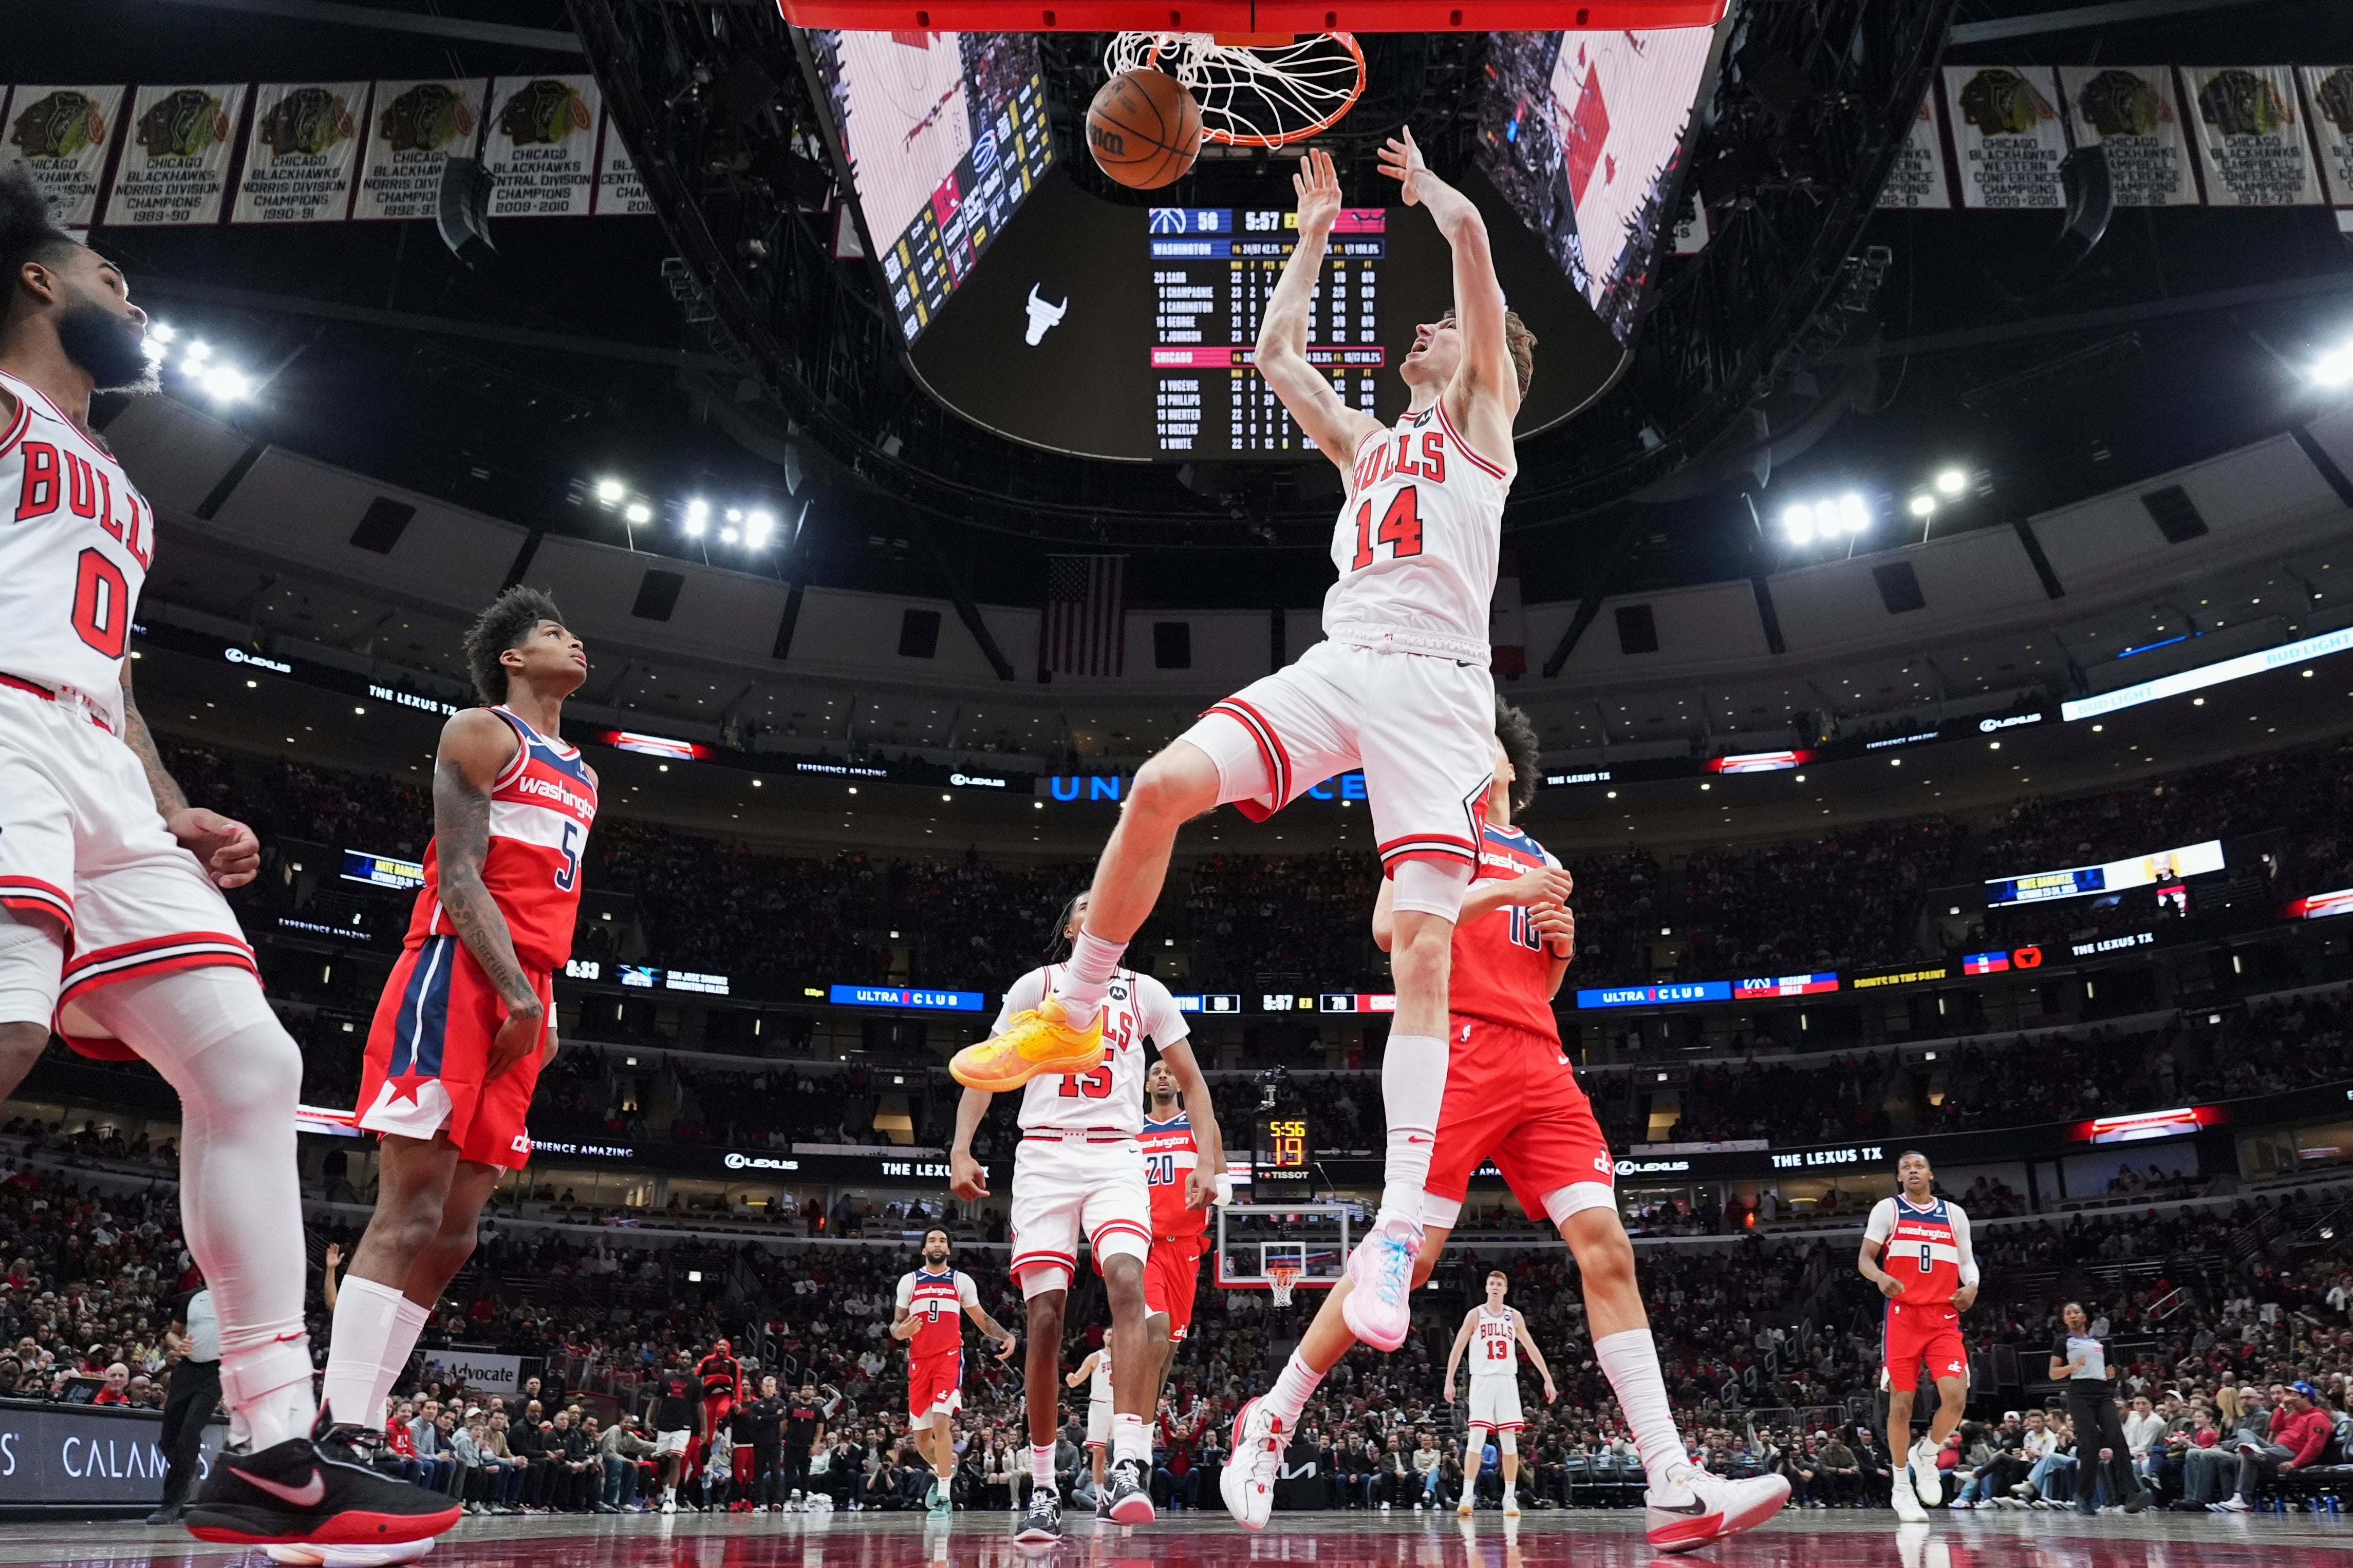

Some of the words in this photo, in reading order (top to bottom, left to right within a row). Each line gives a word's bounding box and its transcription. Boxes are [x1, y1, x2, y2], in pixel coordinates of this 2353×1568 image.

[271, 155, 327, 168] CHICAGO
[512, 148, 568, 161] CHICAGO
[147, 157, 202, 170] CHICAGO
[493, 161, 582, 174] BLACKHAWKS
[127, 169, 215, 183] BLACKHAWKS
[251, 166, 341, 180] BLACKHAWKS
[541, 173, 591, 185] DIVISION
[115, 184, 162, 196] NORRIS
[166, 182, 220, 195] DIVISION
[241, 181, 289, 194] NORRIS
[292, 180, 347, 192] DIVISION
[364, 179, 410, 191] NORRIS
[254, 194, 329, 206] CHAMPIONS
[497, 187, 571, 199] CHAMPIONS
[127, 197, 202, 210] CHAMPIONS
[1245, 211, 1280, 231] 5:57
[1153, 243, 1211, 255] WASHINGTON
[1231, 271, 1242, 284] 22
[1250, 271, 1255, 284] 1
[1265, 271, 1272, 284] 7
[1231, 286, 1242, 298] 23
[1249, 286, 1256, 298] 2
[1231, 300, 1242, 313] 24
[1231, 315, 1242, 328] 21
[1249, 315, 1256, 328] 2
[1250, 330, 1256, 343] 1
[1154, 351, 1193, 364] CHICAGO
[1231, 380, 1242, 392] 22
[1167, 394, 1201, 406] PHILLIPS
[1250, 394, 1256, 406] 1
[1231, 409, 1242, 421] 22
[1250, 409, 1256, 421] 1
[1266, 409, 1273, 421] 5
[1282, 409, 1288, 421] 2
[1282, 423, 1288, 435] 5
[1167, 438, 1192, 449] WHITE
[1231, 438, 1243, 449] 22
[1250, 438, 1256, 449] 1
[1264, 438, 1274, 449] 12
[1348, 431, 1445, 518] BULLS
[14, 441, 154, 574] BULL
[1350, 484, 1423, 572] 14
[71, 547, 128, 660] 0
[2267, 648, 2300, 665] BUD
[2304, 634, 2351, 656] LIGHT
[243, 653, 291, 673] LEXUS
[369, 685, 394, 701] THE
[397, 692, 438, 712] LEXUS
[441, 703, 458, 716] TX
[2078, 698, 2107, 714] BUD
[2111, 687, 2152, 707] LIGHT
[1996, 713, 2042, 728] LEXUS
[796, 763, 847, 775] EXPERIENCE
[849, 767, 888, 778] AMAZING
[965, 777, 1005, 787] LEXUS
[1546, 776, 1565, 785] THE
[1566, 772, 1597, 783] LEXUS
[1598, 771, 1611, 781] TX
[555, 820, 578, 893] 5
[2016, 876, 2037, 891] NATE
[278, 917, 331, 934] EXPERIENCE
[333, 928, 372, 941] AMAZING
[2071, 946, 2095, 957] THE
[2097, 937, 2134, 953] LEXUS
[2136, 933, 2154, 944] TX
[667, 970, 682, 980] SAN
[682, 972, 700, 983] JOSE
[700, 974, 729, 986] SHARKS
[1778, 974, 1812, 987] WIZARDS
[1853, 975, 1888, 989] POINTS
[1888, 974, 1899, 985] IN
[1900, 971, 1918, 983] THE
[1918, 969, 1946, 981] PAINT
[666, 979, 705, 992] EDMONTON
[704, 984, 730, 995] OILERS
[1779, 985, 1803, 996] BULLS
[856, 990, 899, 1004] ULTRA
[912, 992, 958, 1006] CLUB
[1602, 990, 1645, 1004] ULTRA
[1658, 986, 1705, 1000] CLUB
[1263, 994, 1294, 1011] 5:57
[1332, 996, 1347, 1010] 79
[1270, 1121, 1305, 1137] 5:56
[531, 1140, 576, 1154] ERIENCE
[580, 1145, 634, 1158] AMAZING
[1140, 1136, 1189, 1149] ashington
[1276, 1138, 1302, 1165] 19
[1771, 1154, 1802, 1168] THE
[1806, 1149, 1858, 1165] LEXUS
[1861, 1146, 1883, 1160] TX
[744, 1158, 799, 1170] LEXUS
[882, 1162, 911, 1176] THE
[916, 1163, 951, 1177] LEXU
[1146, 1155, 1173, 1184] 20
[1635, 1161, 1689, 1172] LEXUS
[1271, 1171, 1310, 1179] TISSOT
[1897, 1225, 1951, 1241] washington
[1920, 1244, 1931, 1273] 8
[914, 1284, 956, 1296] washington
[929, 1299, 938, 1322] 9
[1480, 1323, 1513, 1342] BULLS
[1486, 1340, 1508, 1360] 13
[450, 1362, 514, 1382] Advocate
